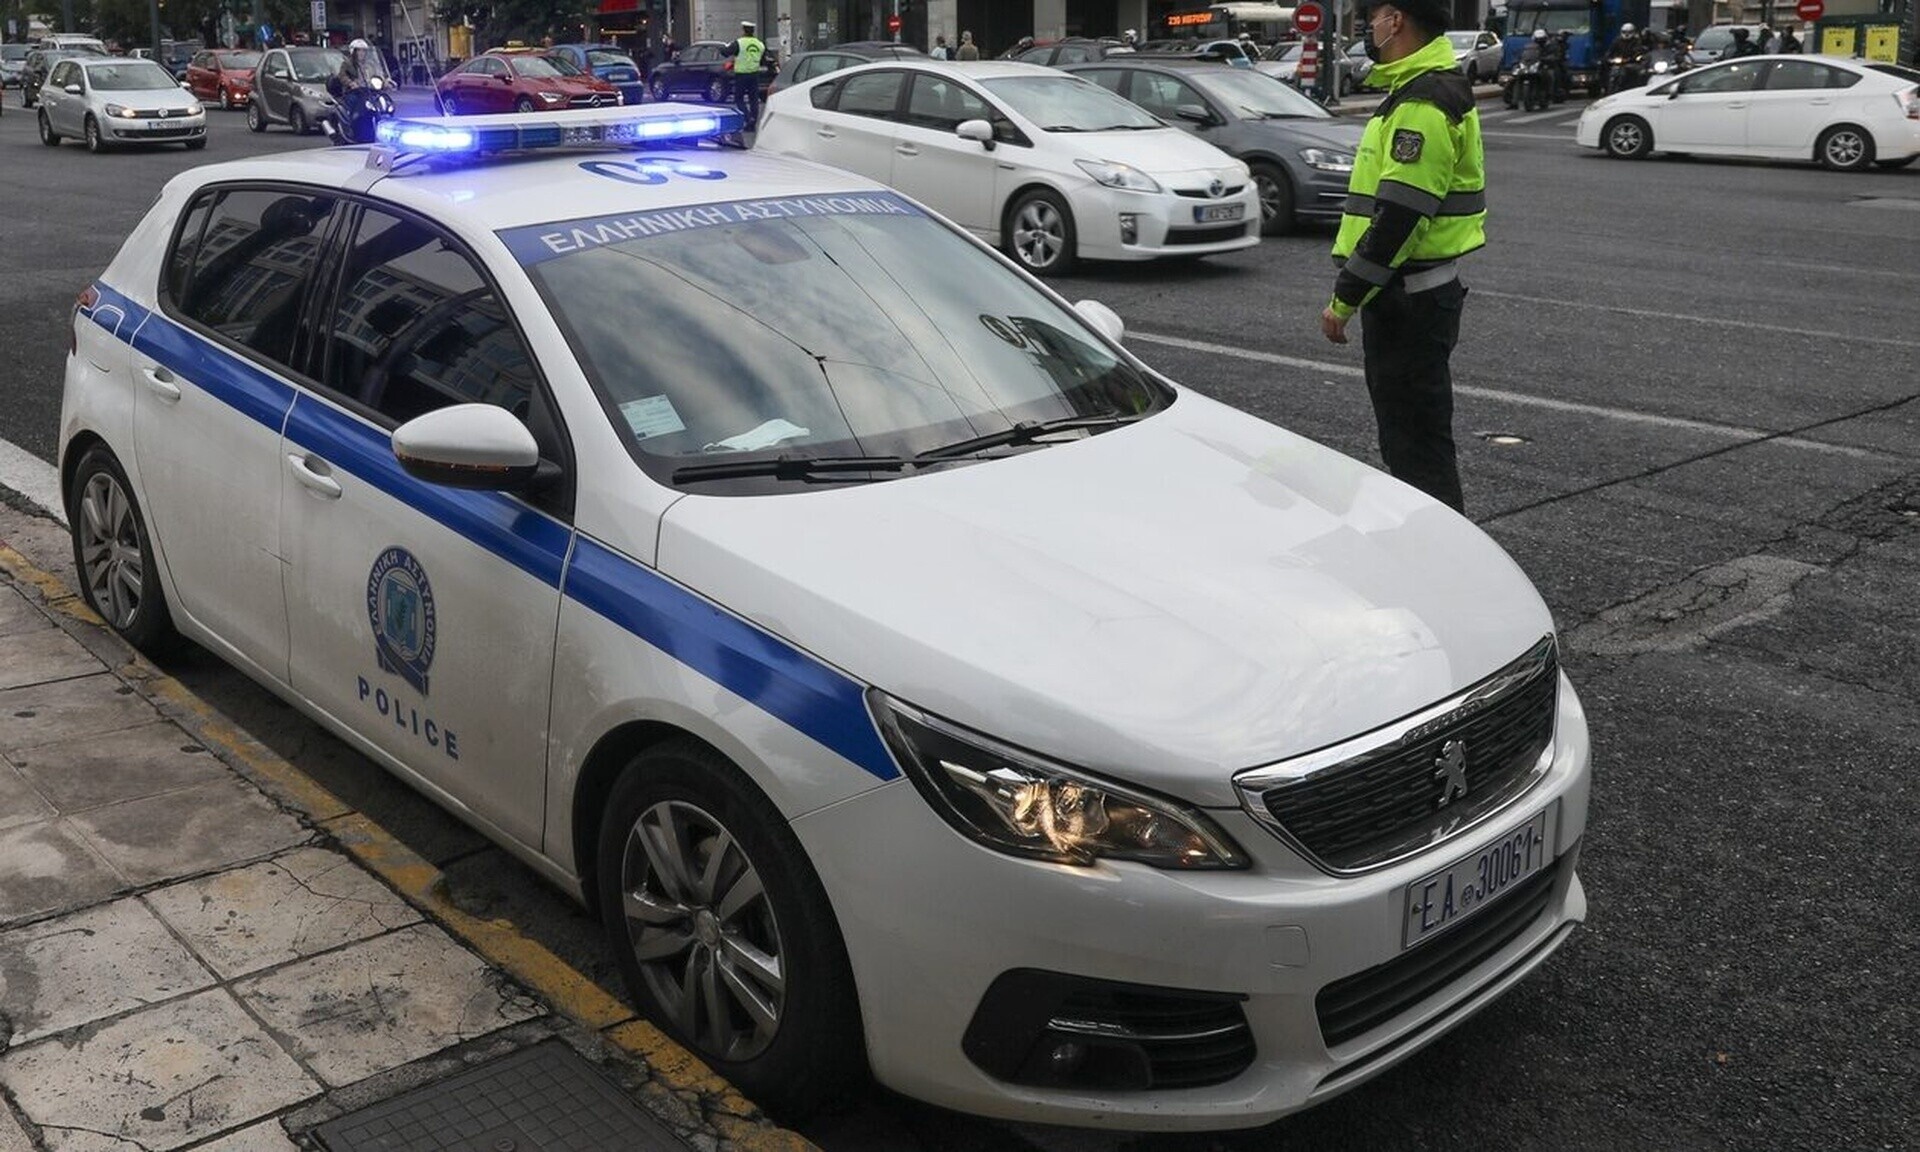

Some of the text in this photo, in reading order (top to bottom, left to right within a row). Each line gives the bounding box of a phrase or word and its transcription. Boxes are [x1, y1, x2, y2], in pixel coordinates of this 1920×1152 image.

[540, 197, 909, 253] ΕΛΛΗΝΙΚΗ ΑΣΤΥΝΟΜΙΑ
[358, 675, 459, 761] POLICE
[1476, 825, 1533, 900] 30061
